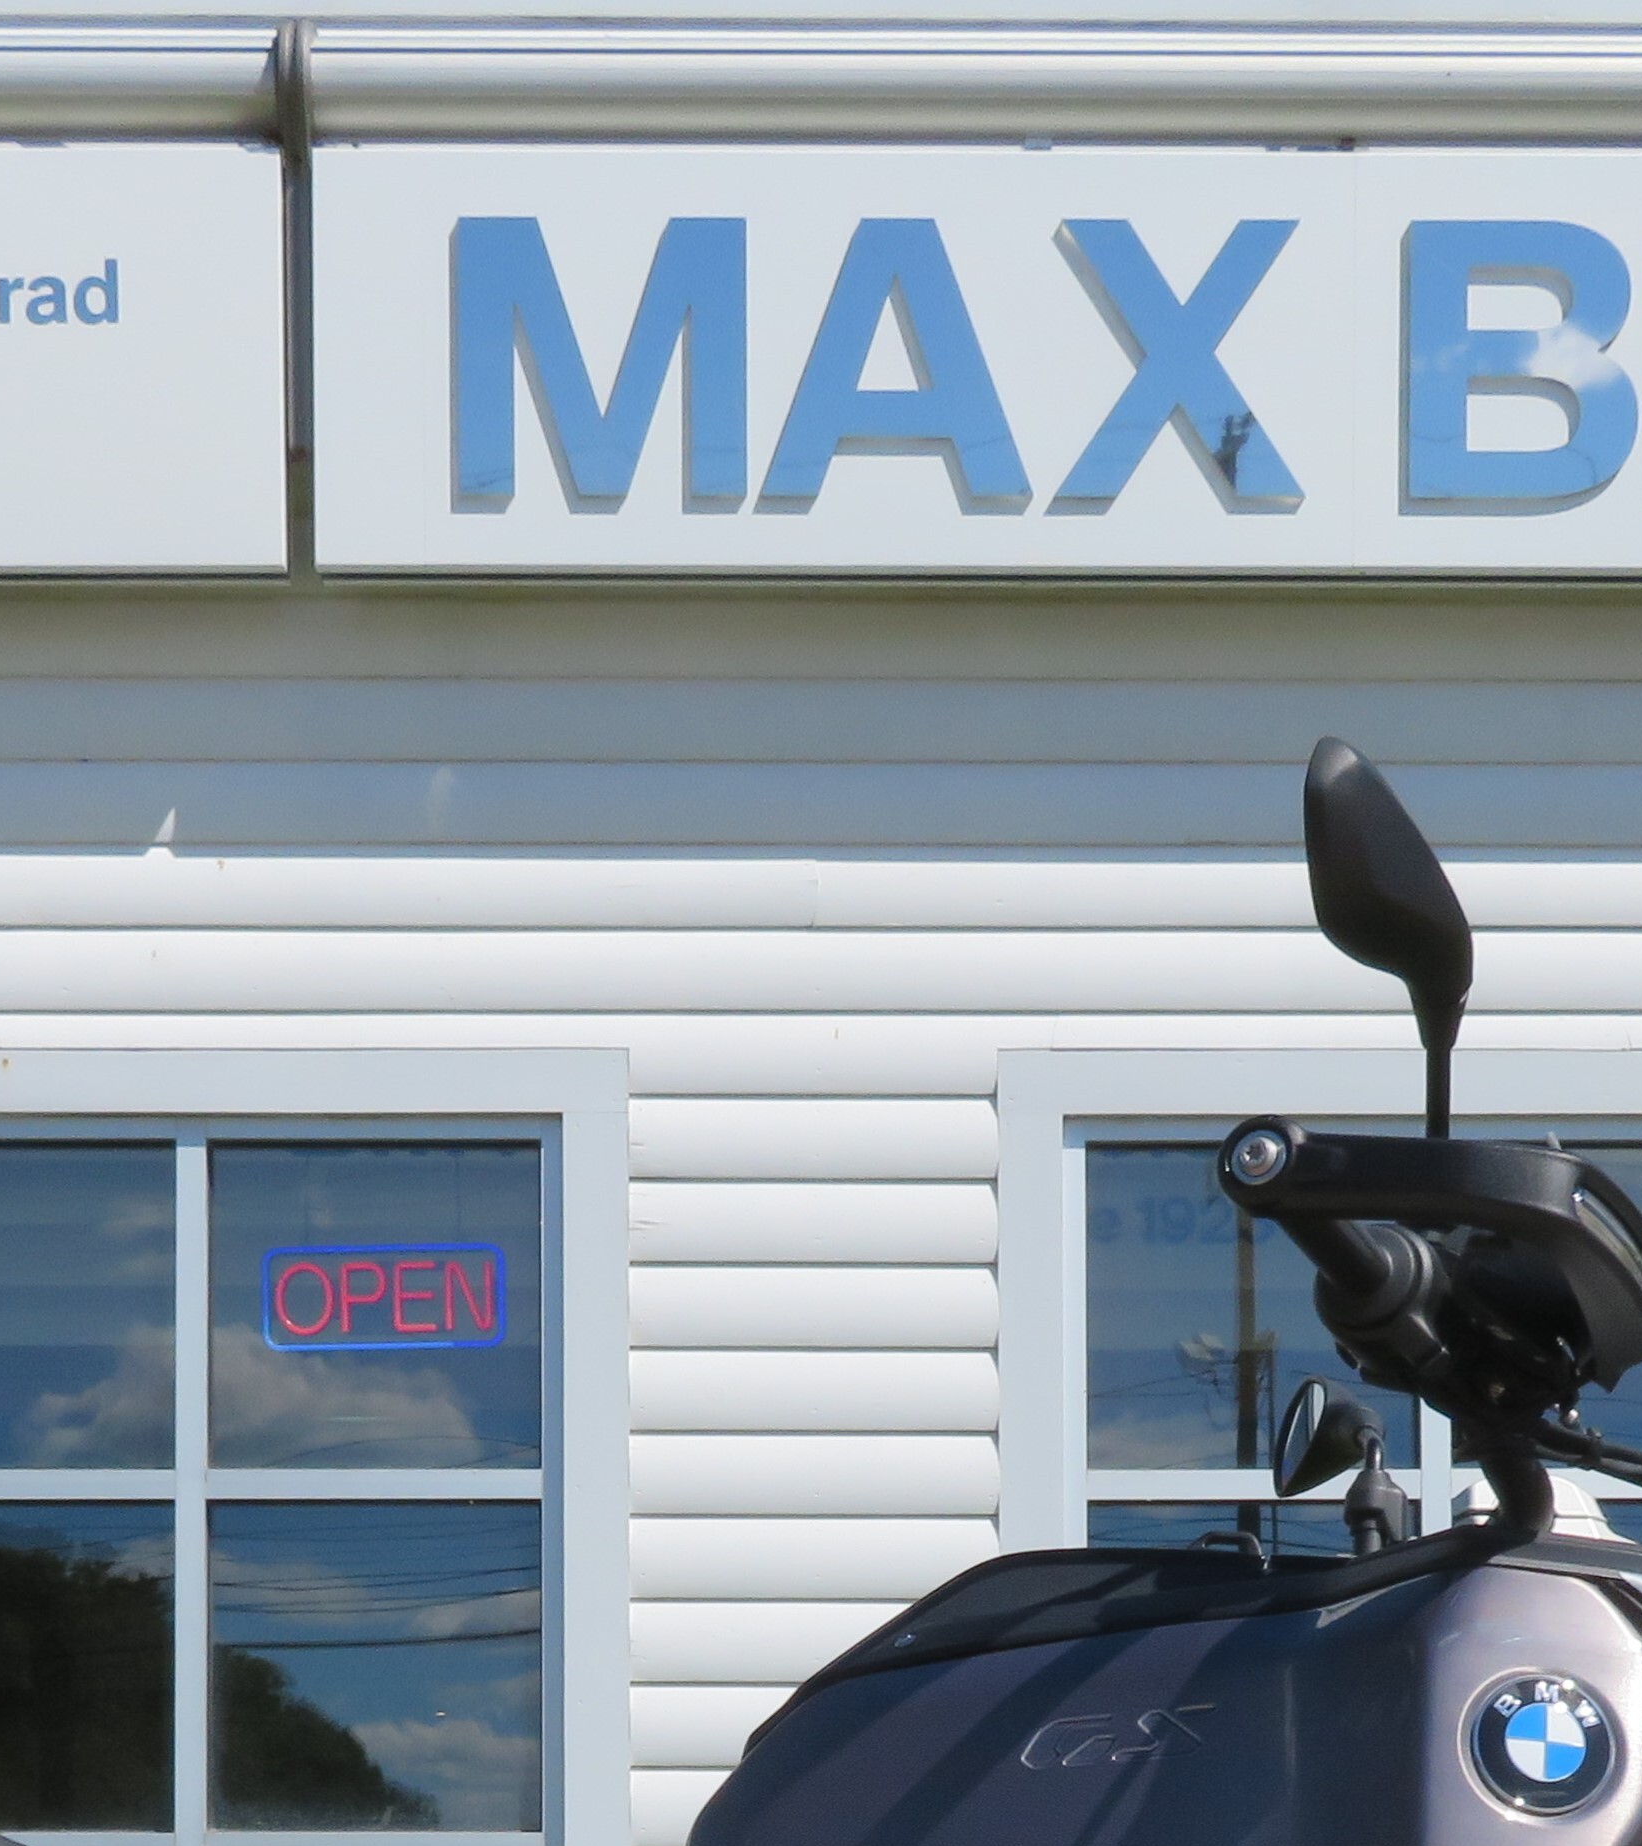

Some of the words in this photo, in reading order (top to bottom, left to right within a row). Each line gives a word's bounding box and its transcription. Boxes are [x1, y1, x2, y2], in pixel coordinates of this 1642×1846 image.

[449, 216, 1305, 515] MAX
[273, 1261, 495, 1336] OPEN
[1020, 1703, 1216, 1770] GS
[1493, 1680, 1601, 1728] BMW
